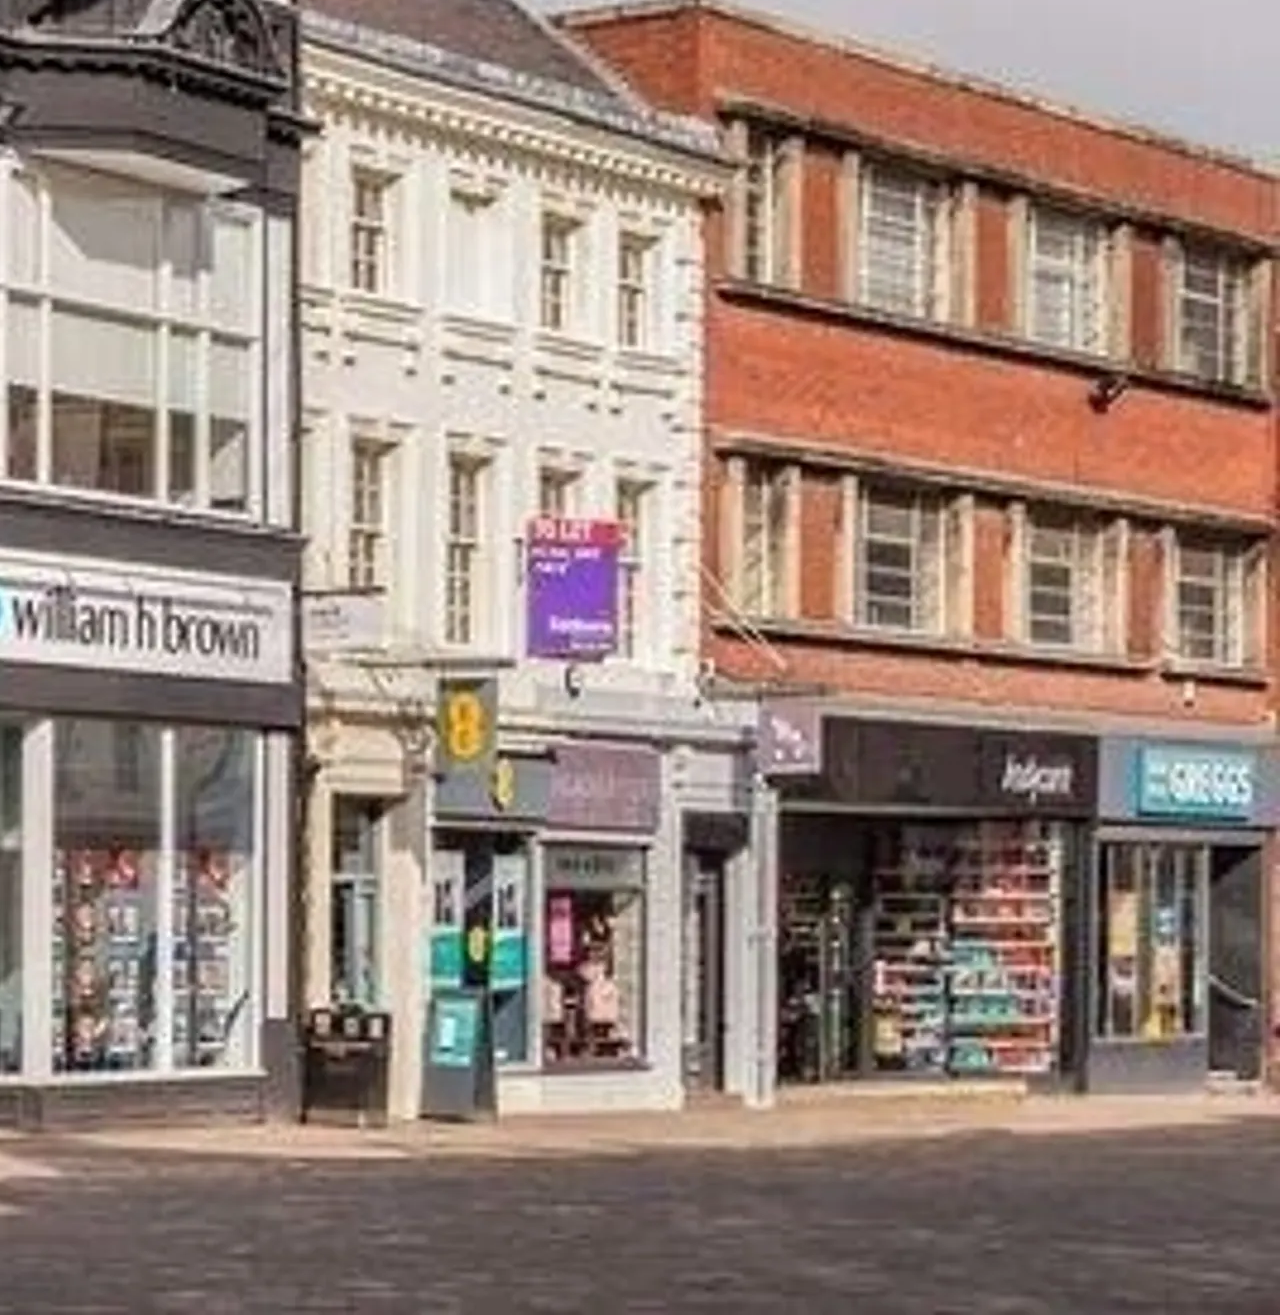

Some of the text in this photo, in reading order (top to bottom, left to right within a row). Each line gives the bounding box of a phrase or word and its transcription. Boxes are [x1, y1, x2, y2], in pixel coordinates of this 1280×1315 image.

[560, 518, 594, 541] LET
[11, 584, 261, 661] william h brown
[1168, 762, 1255, 805] GREGGS
